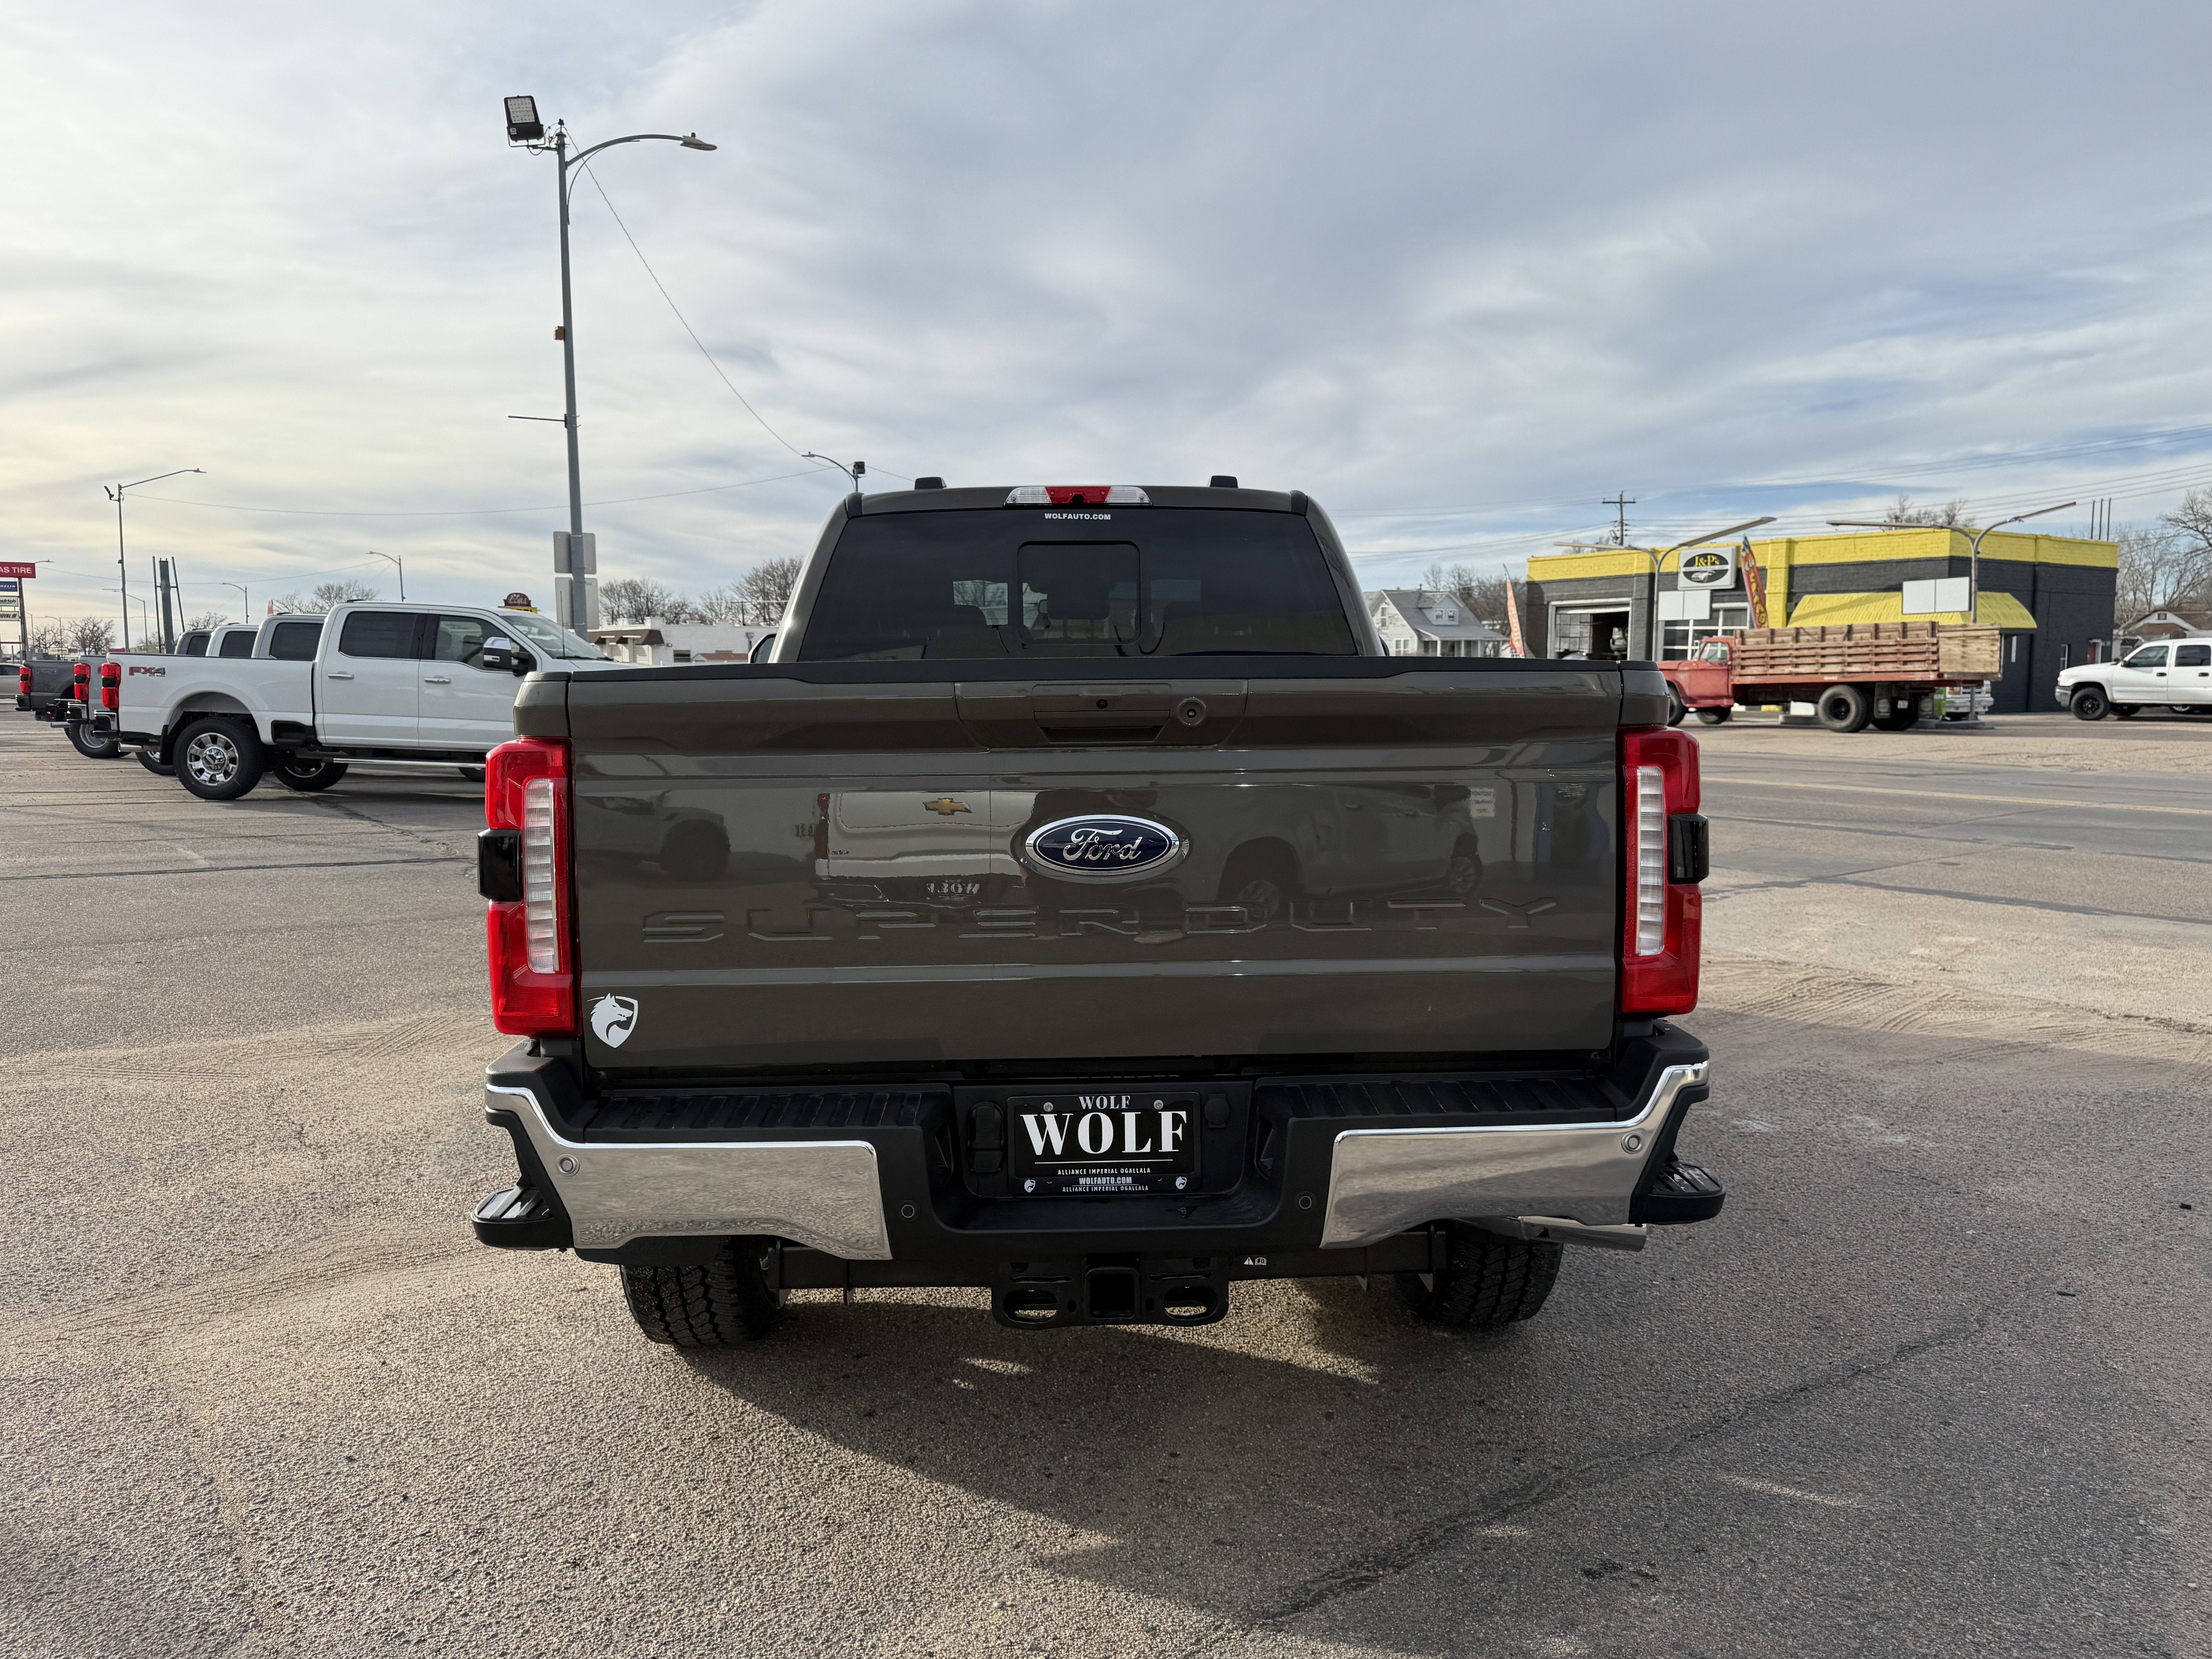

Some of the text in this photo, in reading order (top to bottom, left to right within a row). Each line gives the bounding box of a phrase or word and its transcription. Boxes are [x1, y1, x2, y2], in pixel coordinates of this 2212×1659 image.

[129, 666, 166, 675] FX4
[1063, 828, 1143, 860] Ford
[1079, 1096, 1130, 1109] WOLF
[1020, 1111, 1187, 1155] WOLF
